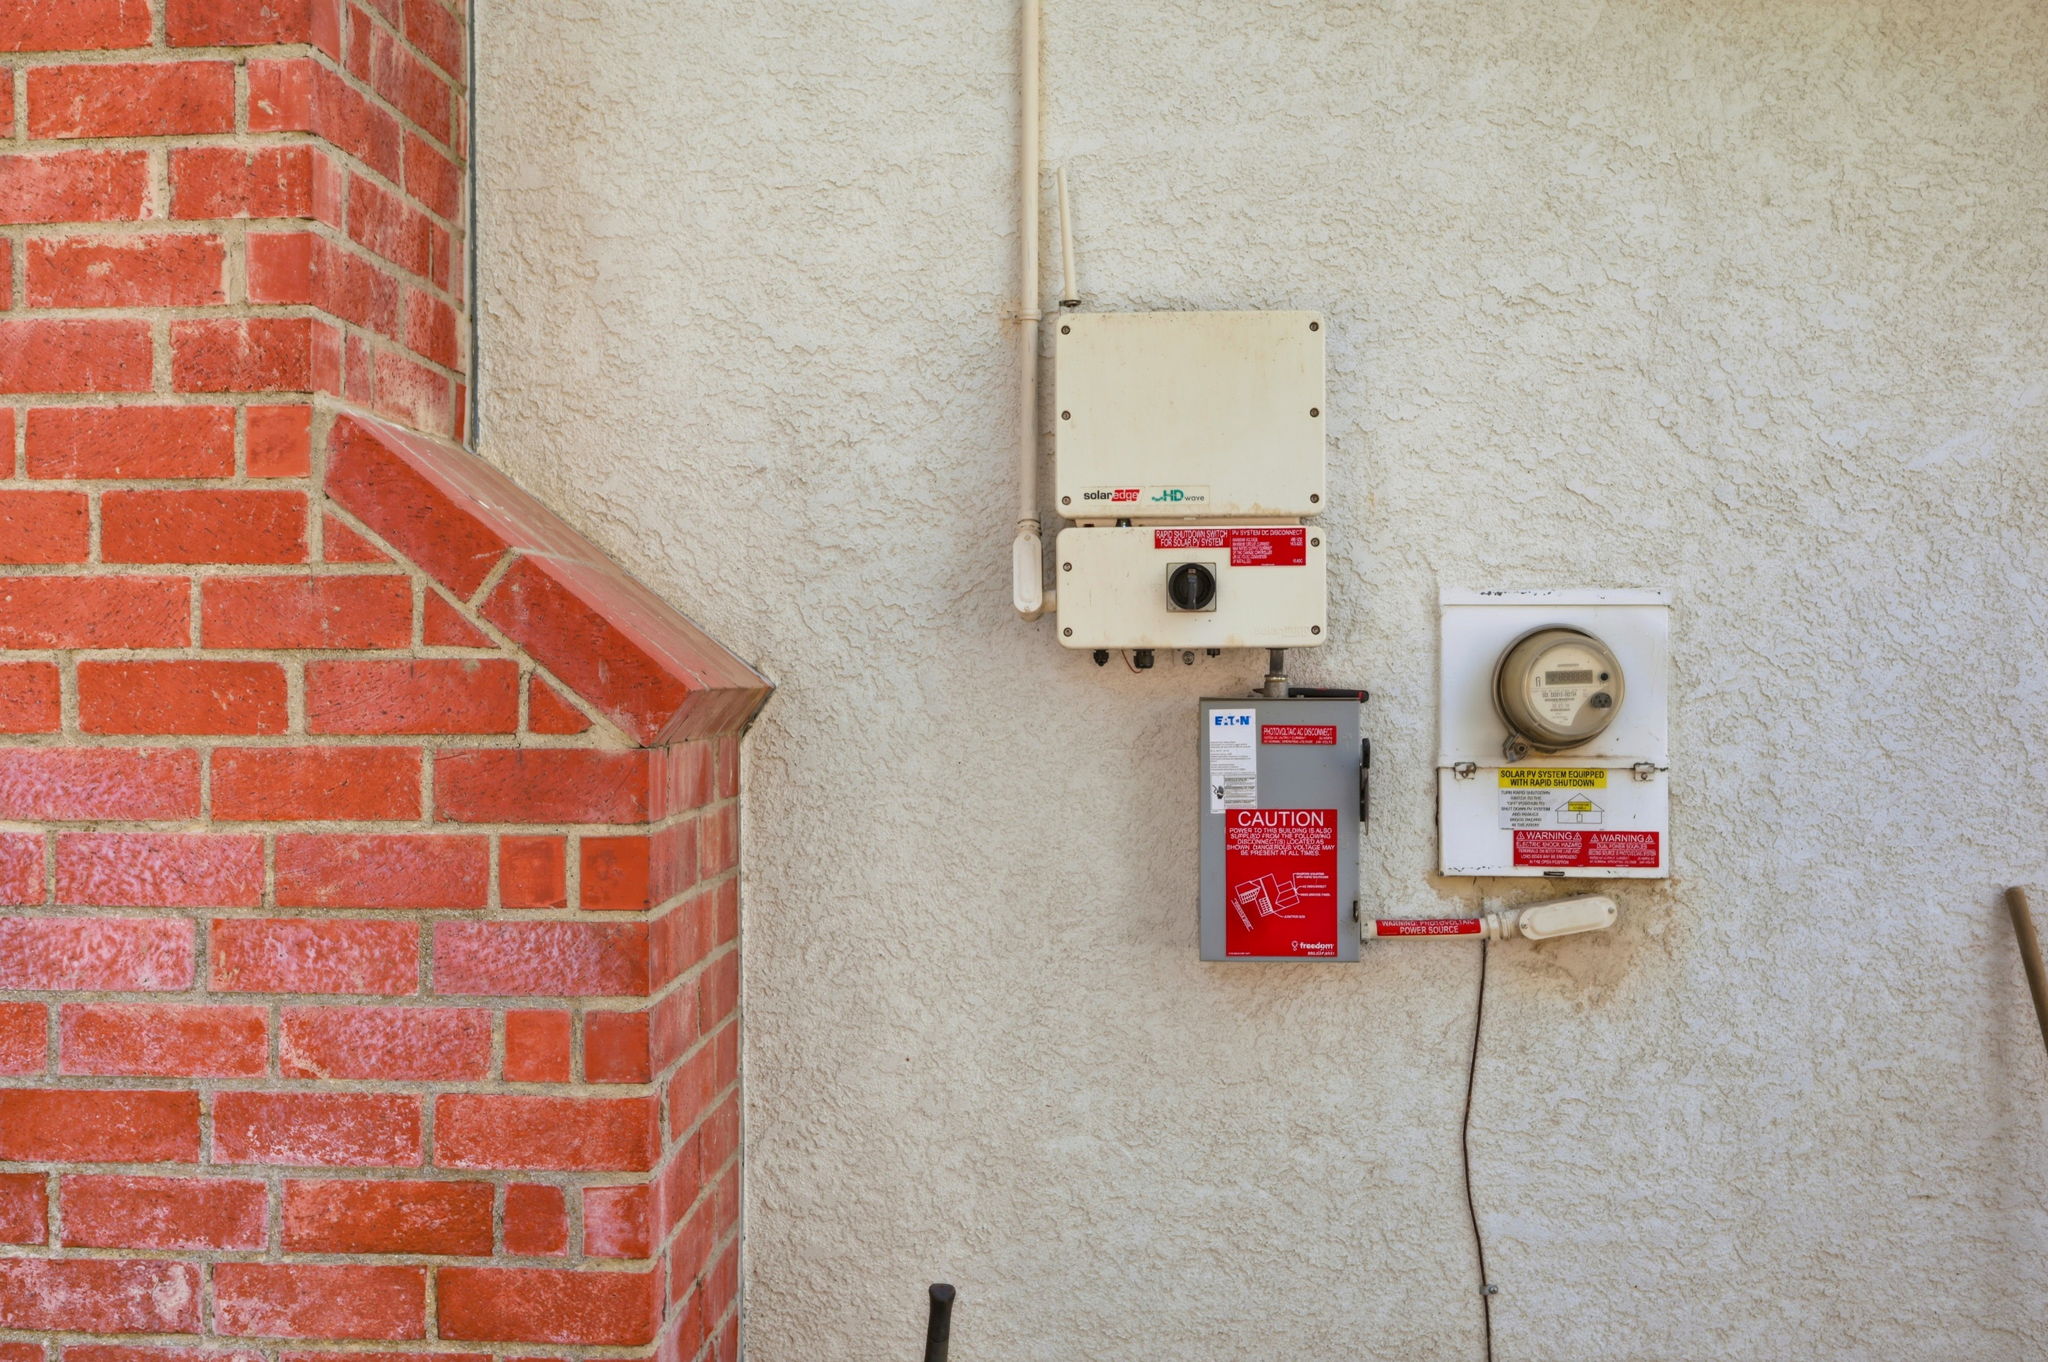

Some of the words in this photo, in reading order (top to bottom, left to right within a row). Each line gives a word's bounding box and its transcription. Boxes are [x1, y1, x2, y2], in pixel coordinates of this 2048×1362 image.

[1083, 489, 1140, 502] solaredge
[1163, 490, 1184, 502] HD
[1156, 530, 1172, 538] RAPID
[1174, 530, 1205, 538] SHUTDOWN
[1206, 530, 1228, 538] SWITCH
[1160, 538, 1172, 546] FOR
[1173, 538, 1192, 546] SOLAR
[1192, 538, 1200, 546] PV
[1201, 538, 1224, 546] SYSTEM
[1264, 728, 1296, 736] PHOTOVOLTAIC
[1297, 728, 1304, 736] AC
[1304, 728, 1333, 736] DISCONNECT
[1500, 770, 1525, 778] SOLAR
[1526, 770, 1536, 778] PV
[1538, 770, 1566, 778] SYSTEM
[1568, 770, 1604, 778] EQUIPPED
[1238, 811, 1324, 826] CAUTION
[1400, 926, 1427, 934] POWER
[1428, 926, 1459, 934] SOURCE
[1300, 942, 1334, 950] freedom
